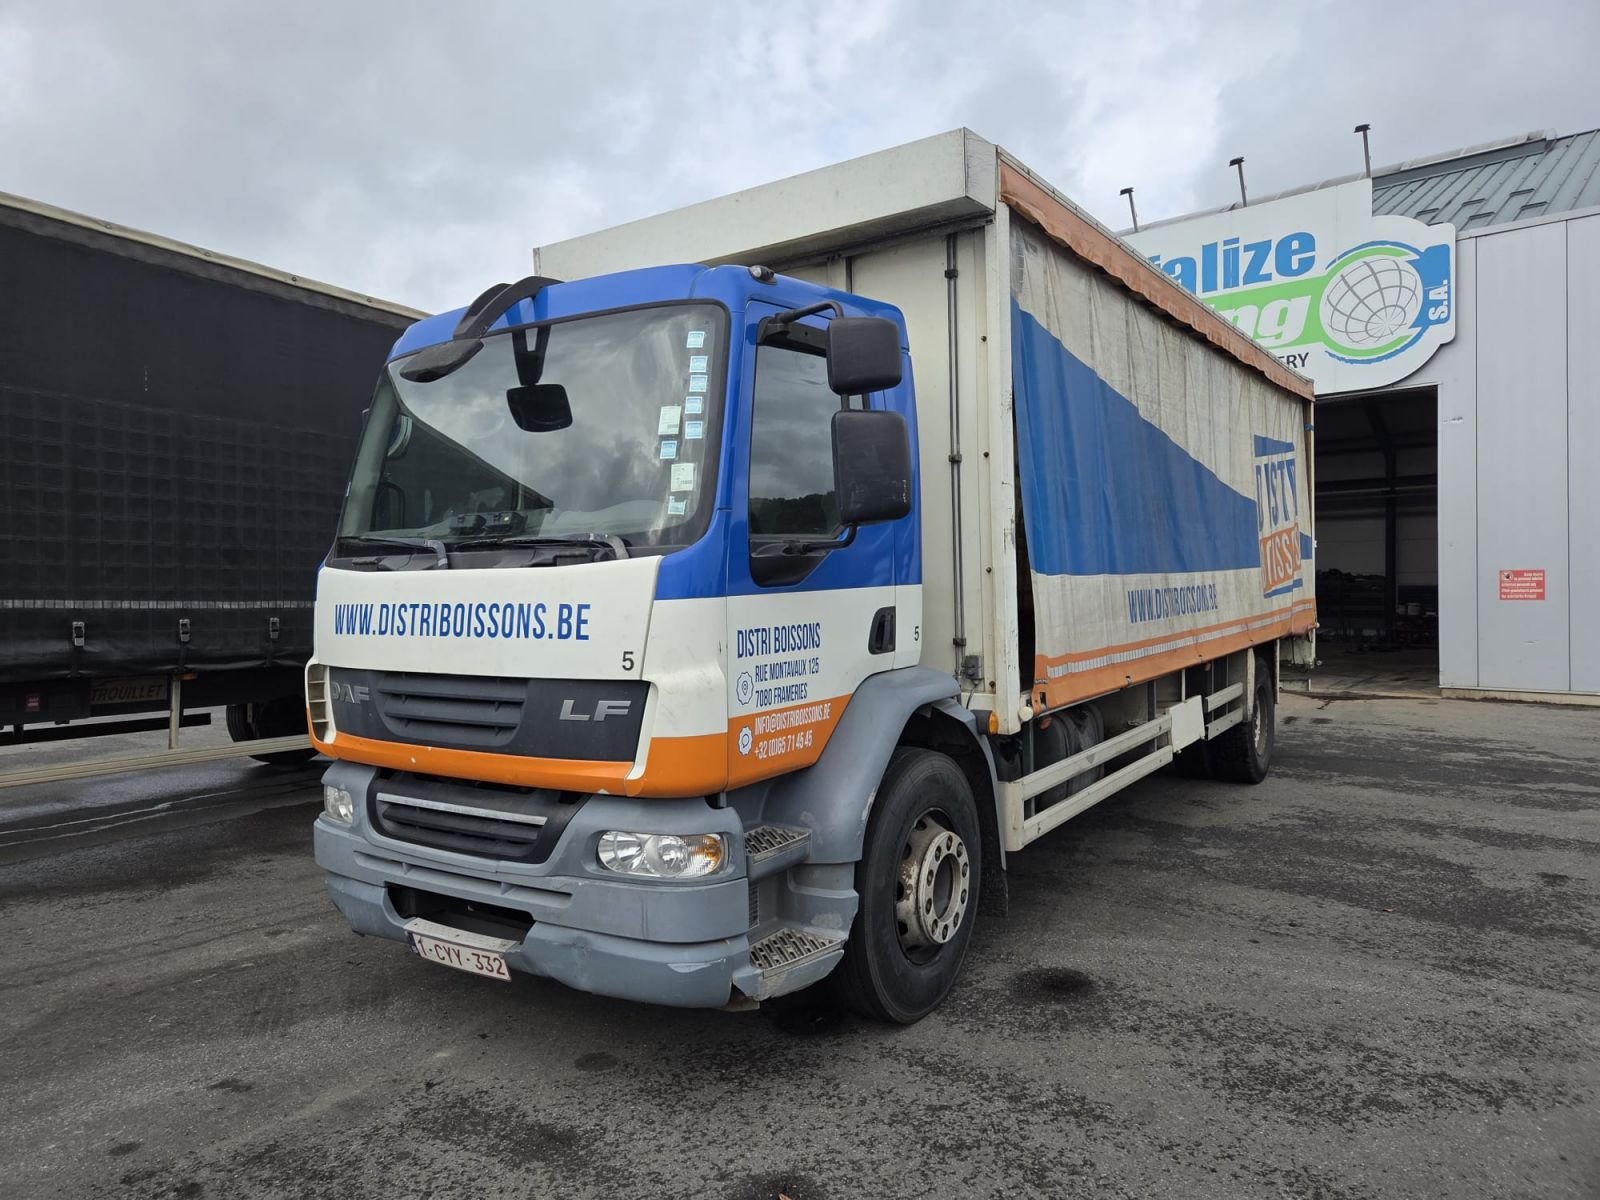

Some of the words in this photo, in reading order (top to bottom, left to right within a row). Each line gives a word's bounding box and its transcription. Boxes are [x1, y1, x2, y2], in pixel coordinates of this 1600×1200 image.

[1428, 279, 1448, 320] S.A.
[1210, 295, 1312, 347] ng
[334, 602, 591, 640] WWW.DISTRIBOISSONS.BE
[914, 626, 920, 641] 5
[737, 627, 771, 658] DISTRI
[774, 622, 821, 654] BOISSONS
[621, 651, 635, 671] 5
[755, 663, 768, 683] RUE
[769, 660, 807, 680] MONTAVAUX
[808, 657, 820, 675] 125
[331, 681, 369, 704] DAF
[755, 687, 772, 708] 7080
[774, 683, 808, 705] FRAMERIES
[559, 699, 632, 721] LF
